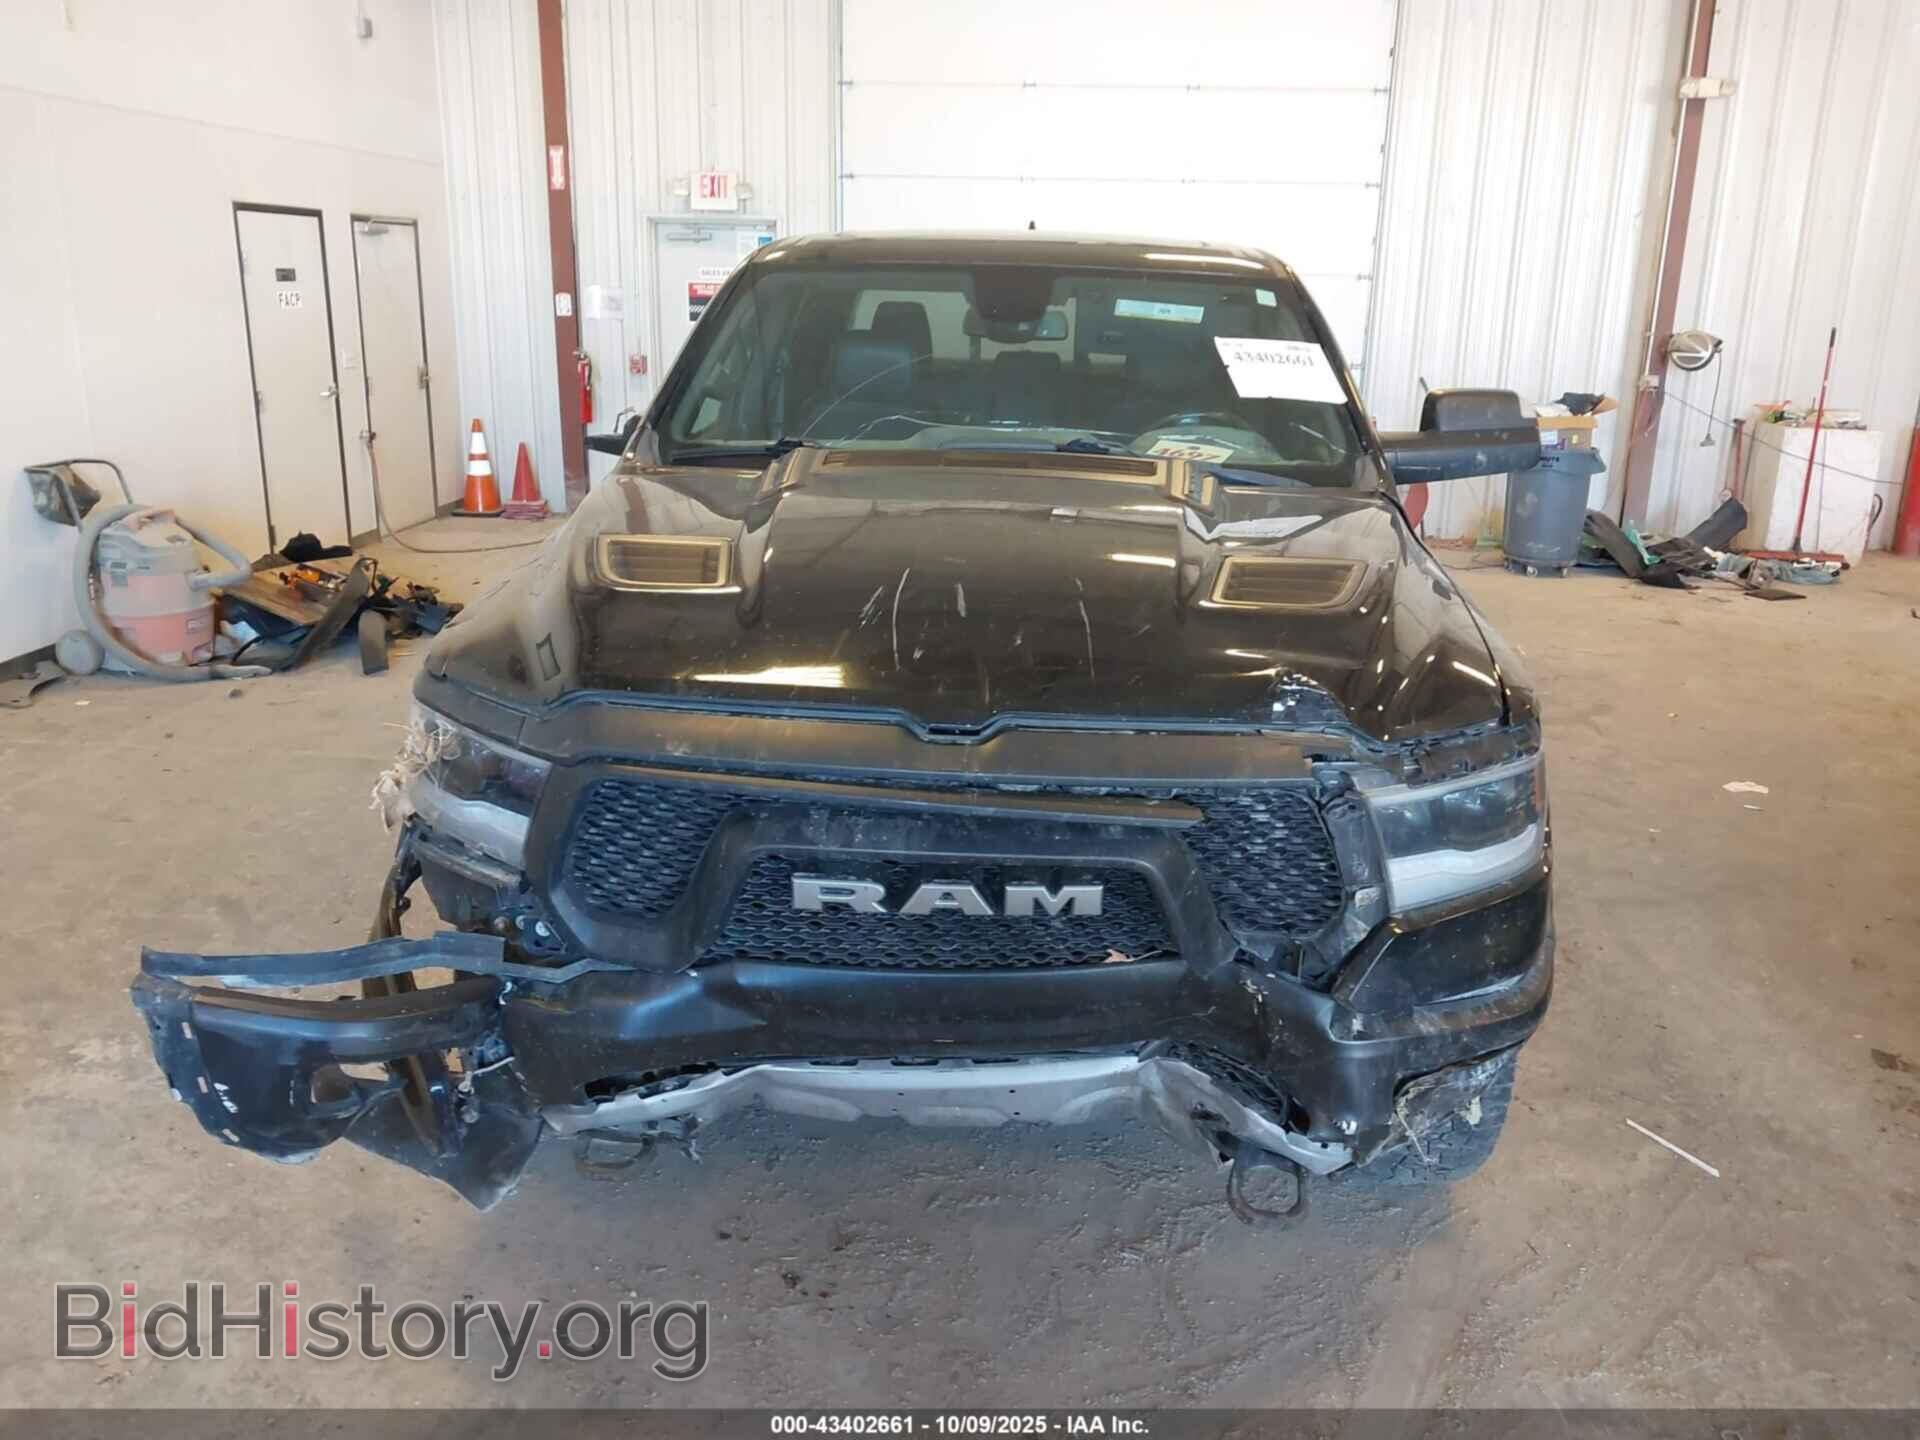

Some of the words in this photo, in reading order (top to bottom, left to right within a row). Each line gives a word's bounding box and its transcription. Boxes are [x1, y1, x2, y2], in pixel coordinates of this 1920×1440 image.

[700, 175, 729, 198] EXIT
[279, 292, 301, 307] FACP
[1234, 351, 1315, 367] 43402661
[792, 875, 1104, 915] RAM
